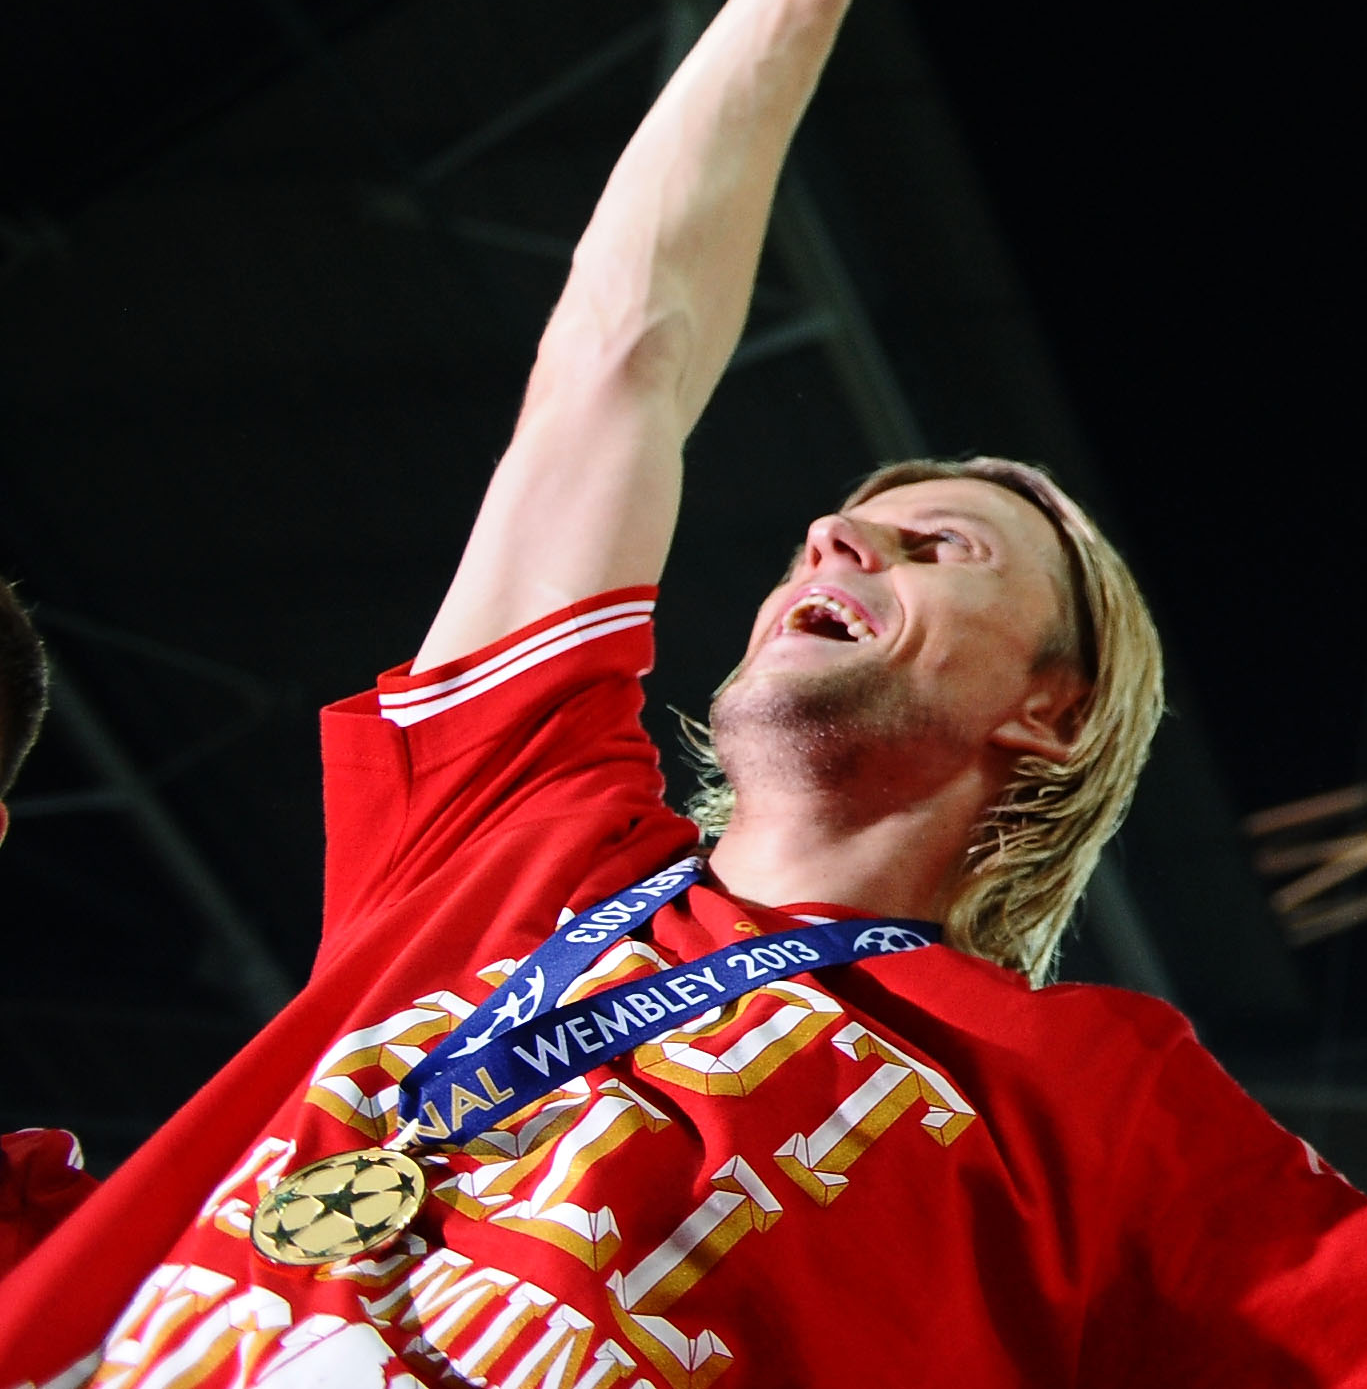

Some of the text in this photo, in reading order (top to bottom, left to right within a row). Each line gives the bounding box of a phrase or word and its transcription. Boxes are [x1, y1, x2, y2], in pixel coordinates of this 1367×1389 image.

[564, 900, 647, 943] 2013
[513, 966, 726, 1078] WEMBLEY
[726, 938, 821, 980] 2013
